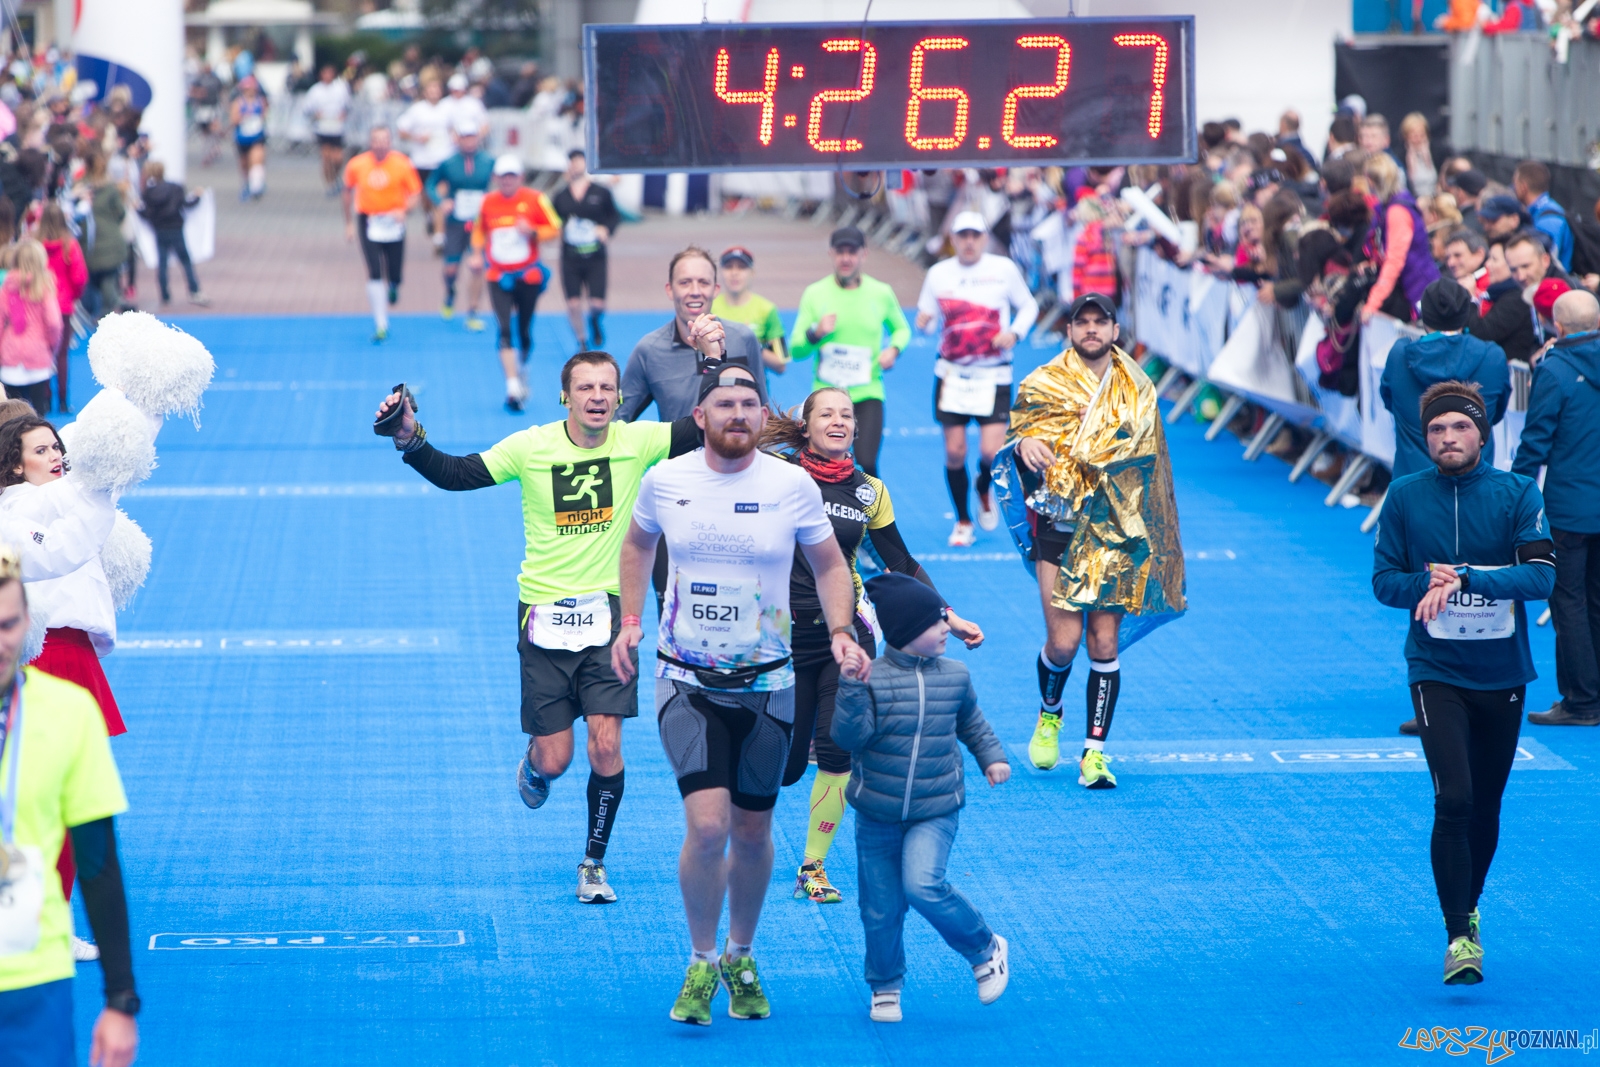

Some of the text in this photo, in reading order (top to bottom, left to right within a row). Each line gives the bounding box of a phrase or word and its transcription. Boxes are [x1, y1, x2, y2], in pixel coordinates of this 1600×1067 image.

[567, 509, 603, 523] night
[557, 520, 611, 535] runners
[690, 521, 717, 532] SIŁA
[697, 532, 755, 543] ODWAGA
[689, 541, 755, 554] SZYBKOŚĆ
[692, 603, 739, 621] 6621
[1448, 610, 1495, 619] Przemysław
[552, 612, 594, 627] 3414
[699, 623, 731, 632] Tomasz
[1299, 750, 1418, 760] PKO
[179, 935, 326, 945] PKO
